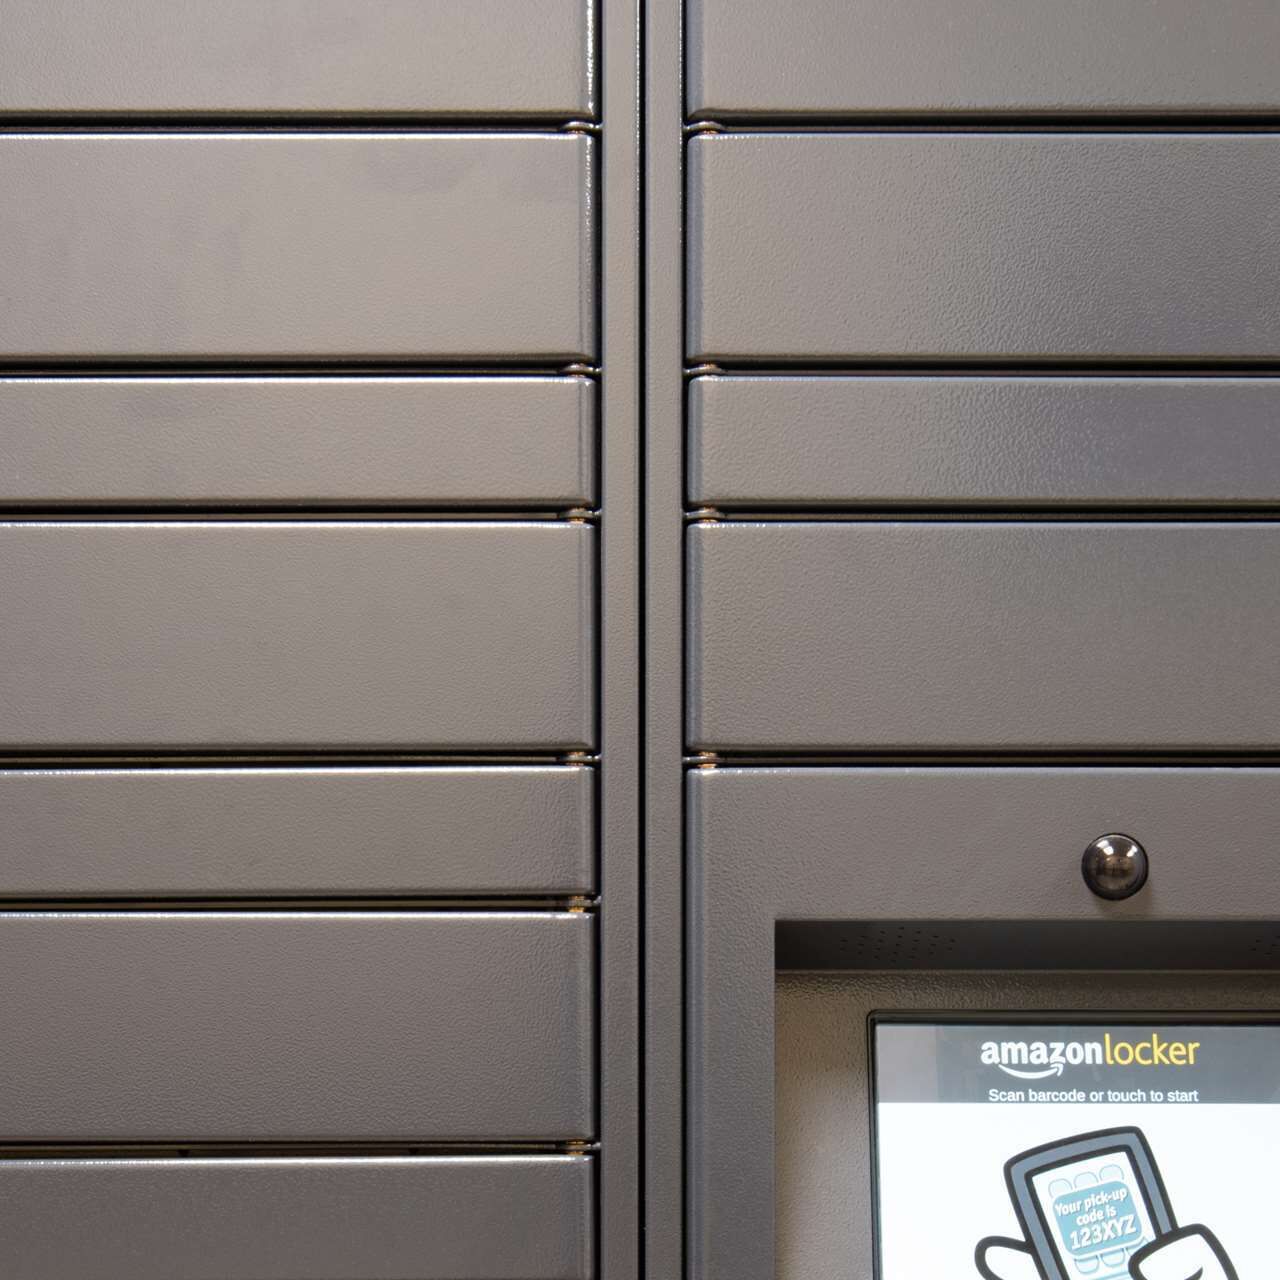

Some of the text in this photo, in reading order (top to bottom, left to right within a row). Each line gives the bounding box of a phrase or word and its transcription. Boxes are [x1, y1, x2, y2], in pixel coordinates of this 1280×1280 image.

[988, 1088, 1199, 1102] Scan barcode or touch to start
[1055, 1188, 1128, 1217] Your pick-up
[1076, 1205, 1117, 1226] code is
[1070, 1214, 1137, 1250] 123XYZ
